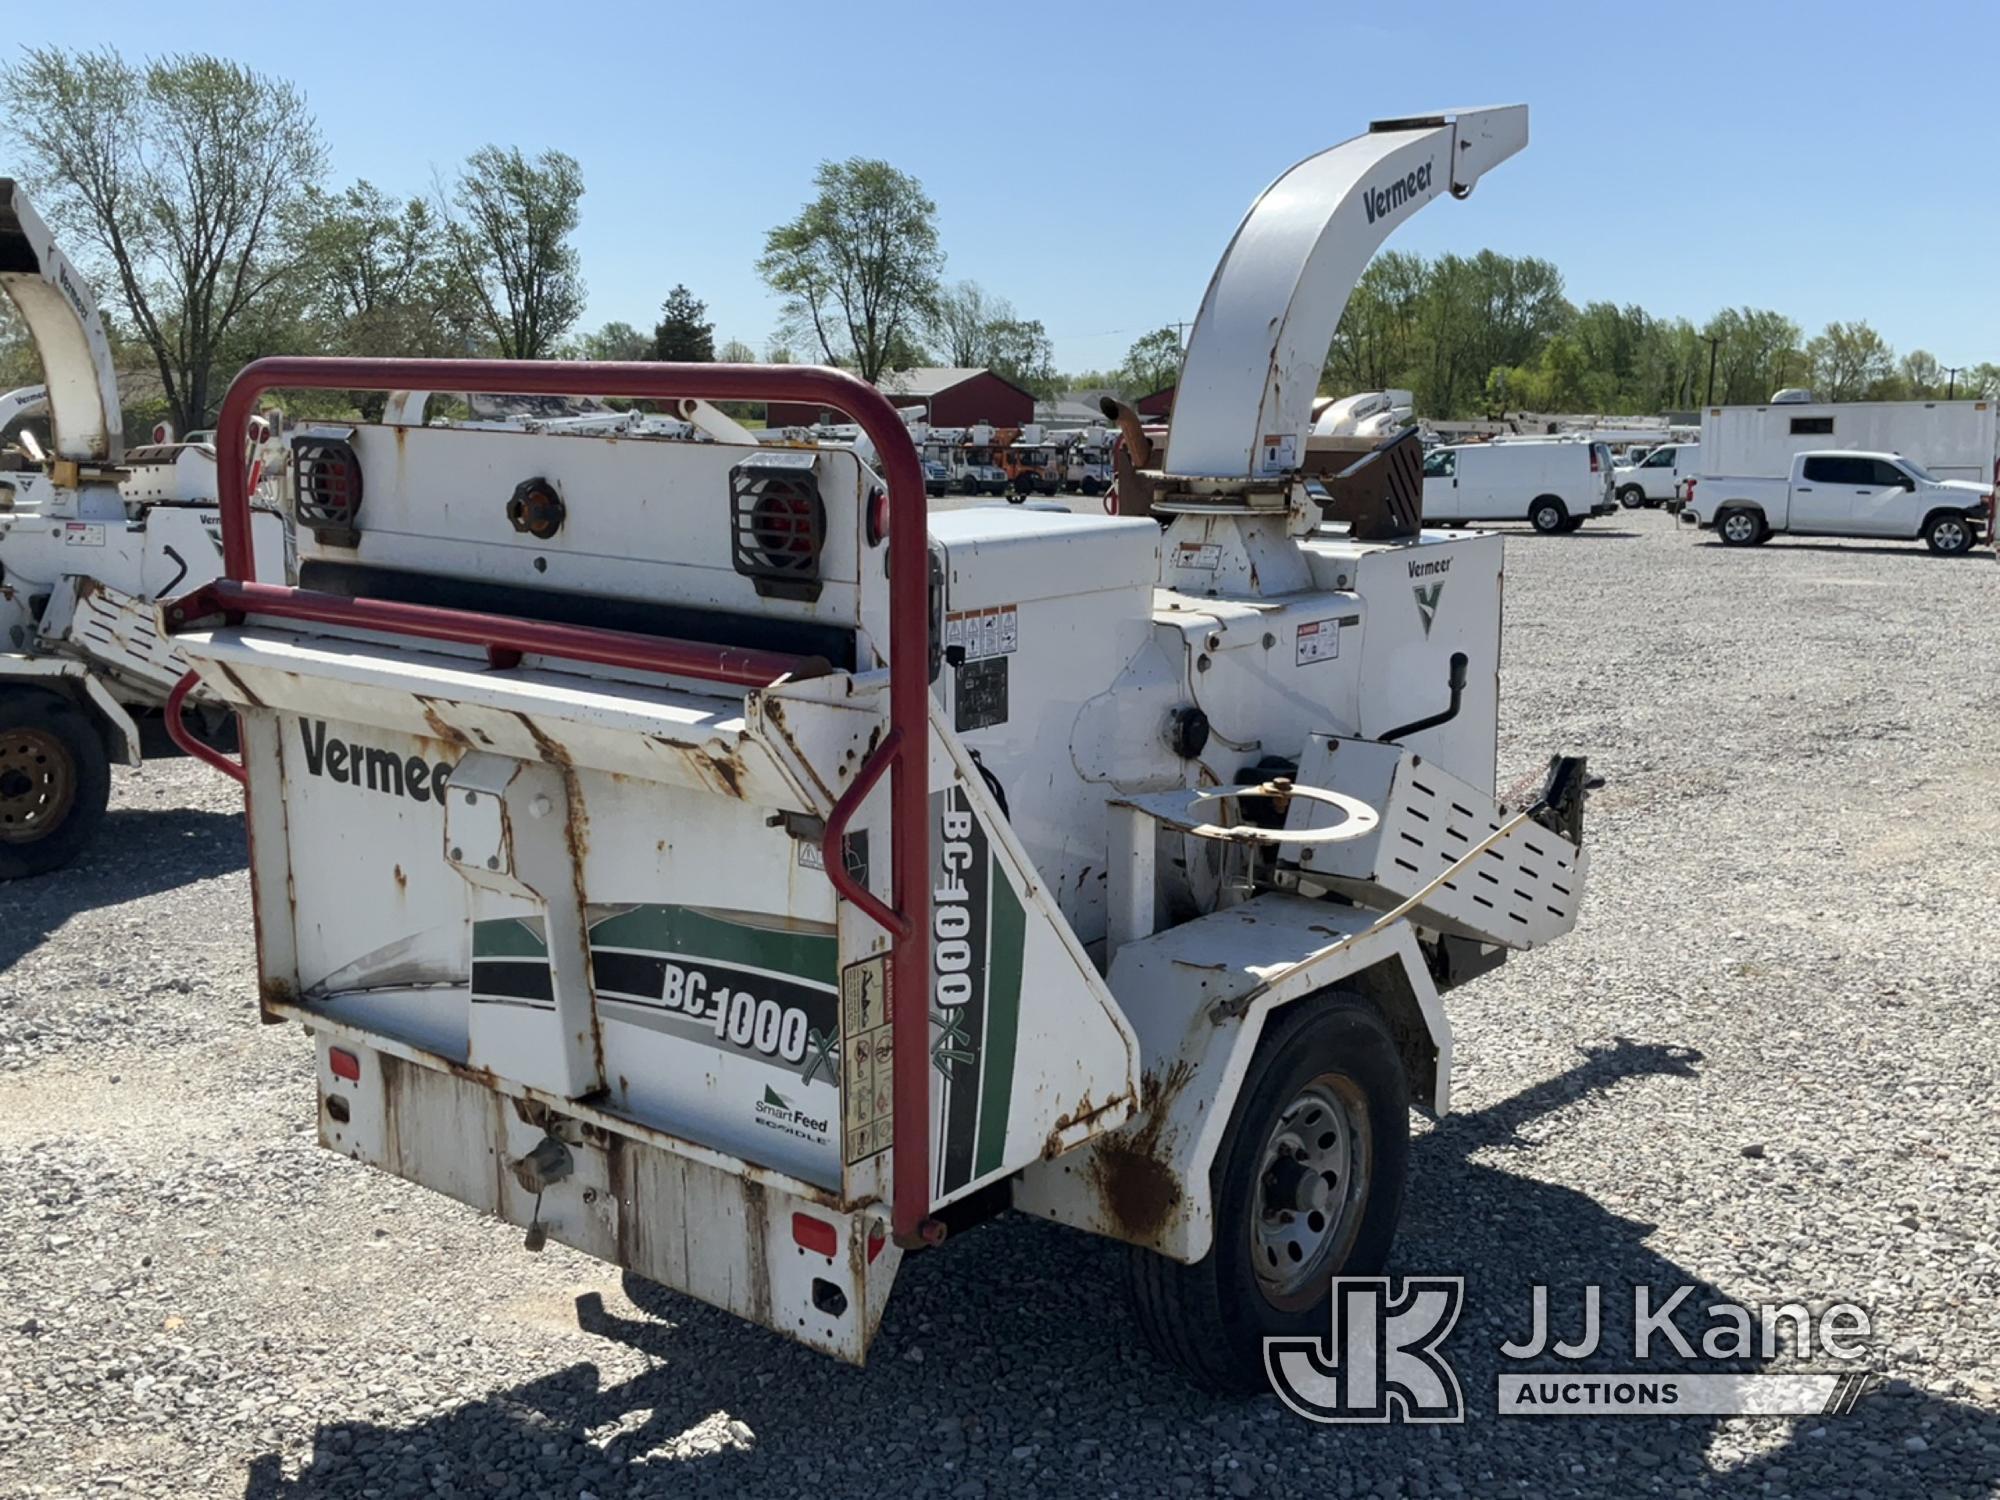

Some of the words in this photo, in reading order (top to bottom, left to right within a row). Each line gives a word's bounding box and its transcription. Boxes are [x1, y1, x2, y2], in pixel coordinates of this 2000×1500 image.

[1363, 162, 1432, 224] Vermeer
[1408, 559, 1450, 578] Vermeer
[299, 717, 453, 806] Vermee
